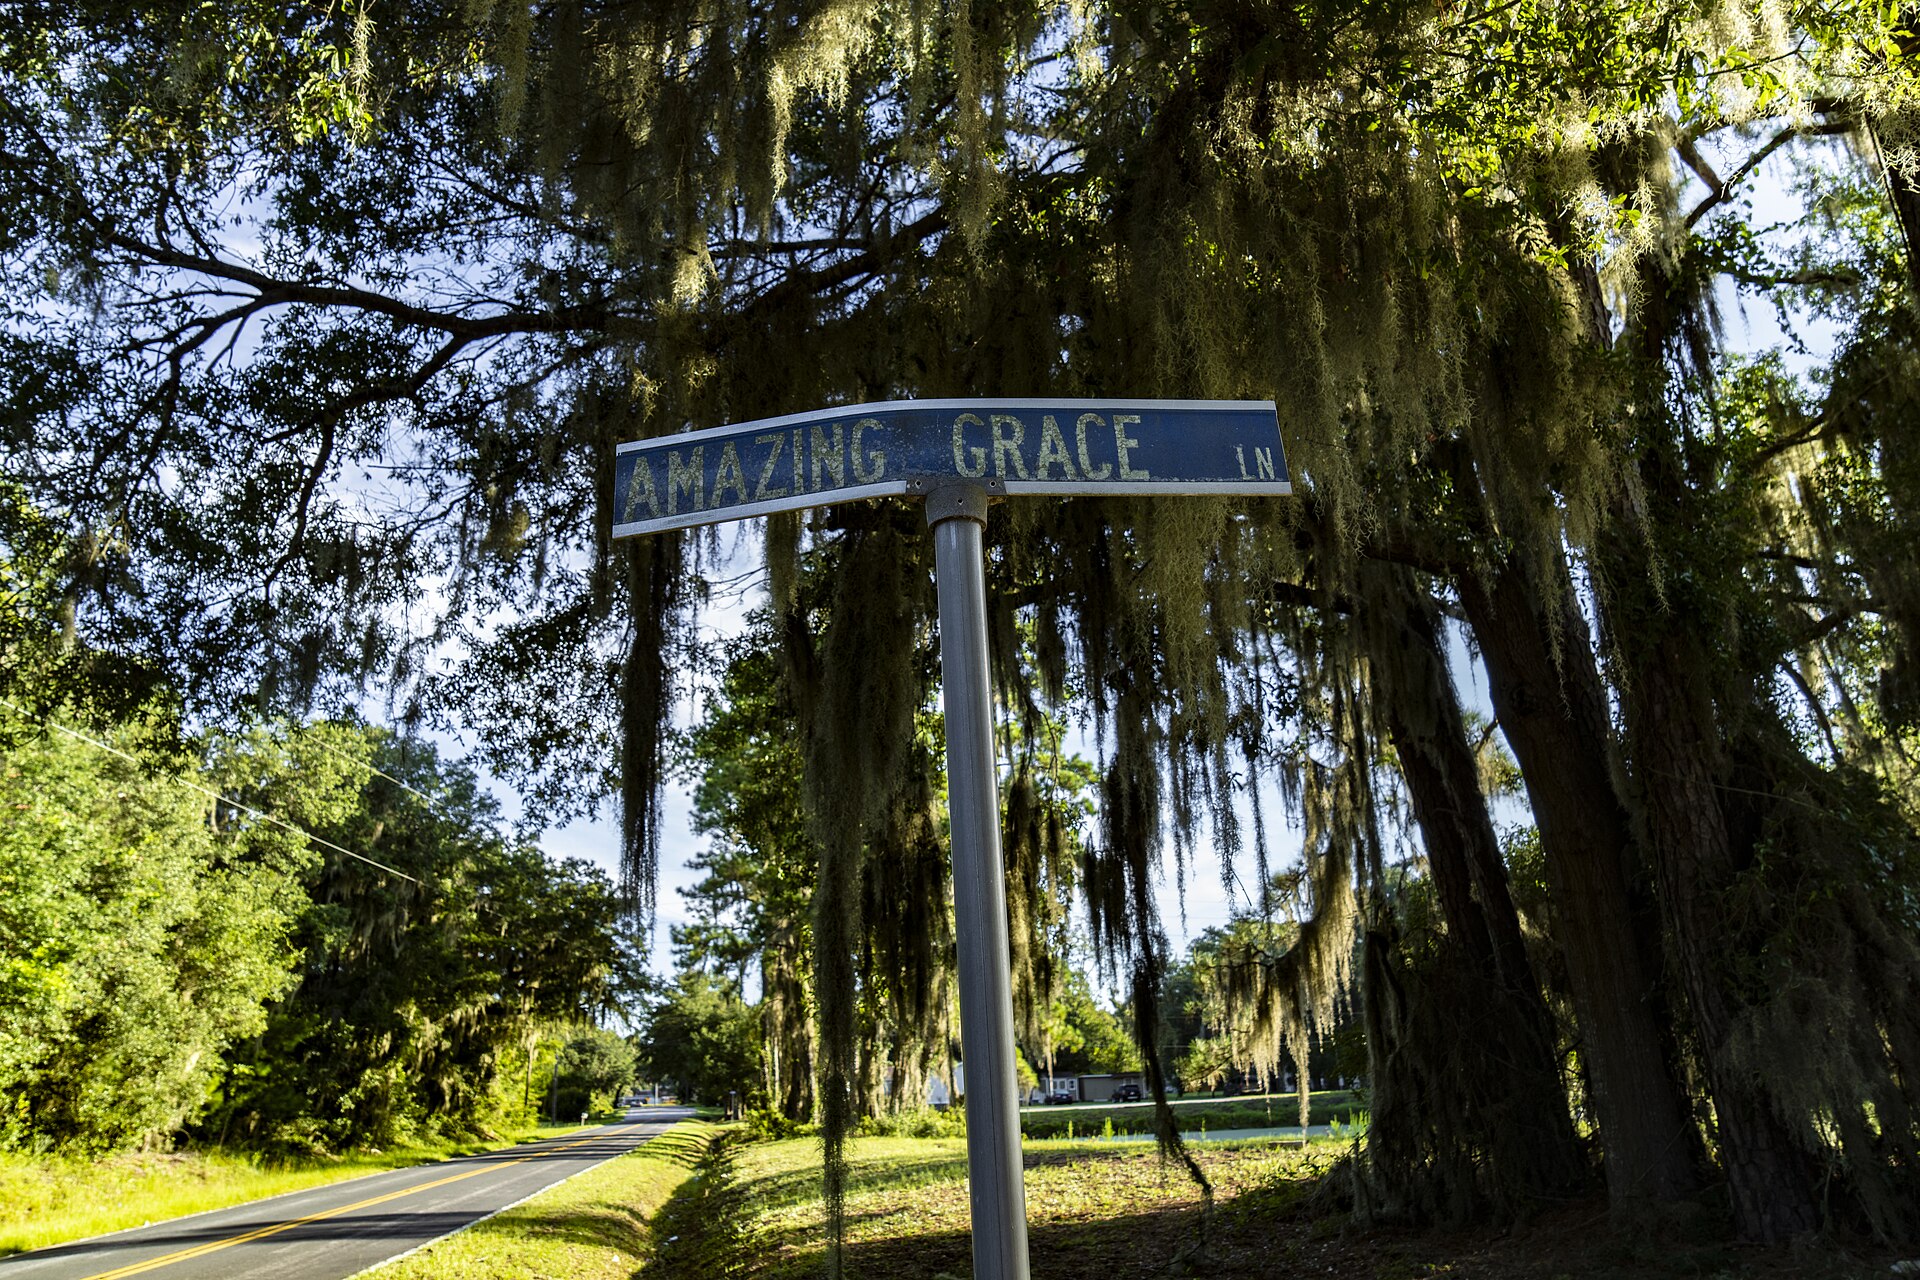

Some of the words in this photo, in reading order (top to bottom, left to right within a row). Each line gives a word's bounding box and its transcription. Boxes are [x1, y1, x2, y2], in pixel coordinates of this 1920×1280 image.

[624, 418, 886, 521] AMAZING
[953, 413, 1149, 480] GRACE
[1236, 445, 1275, 480] LN
